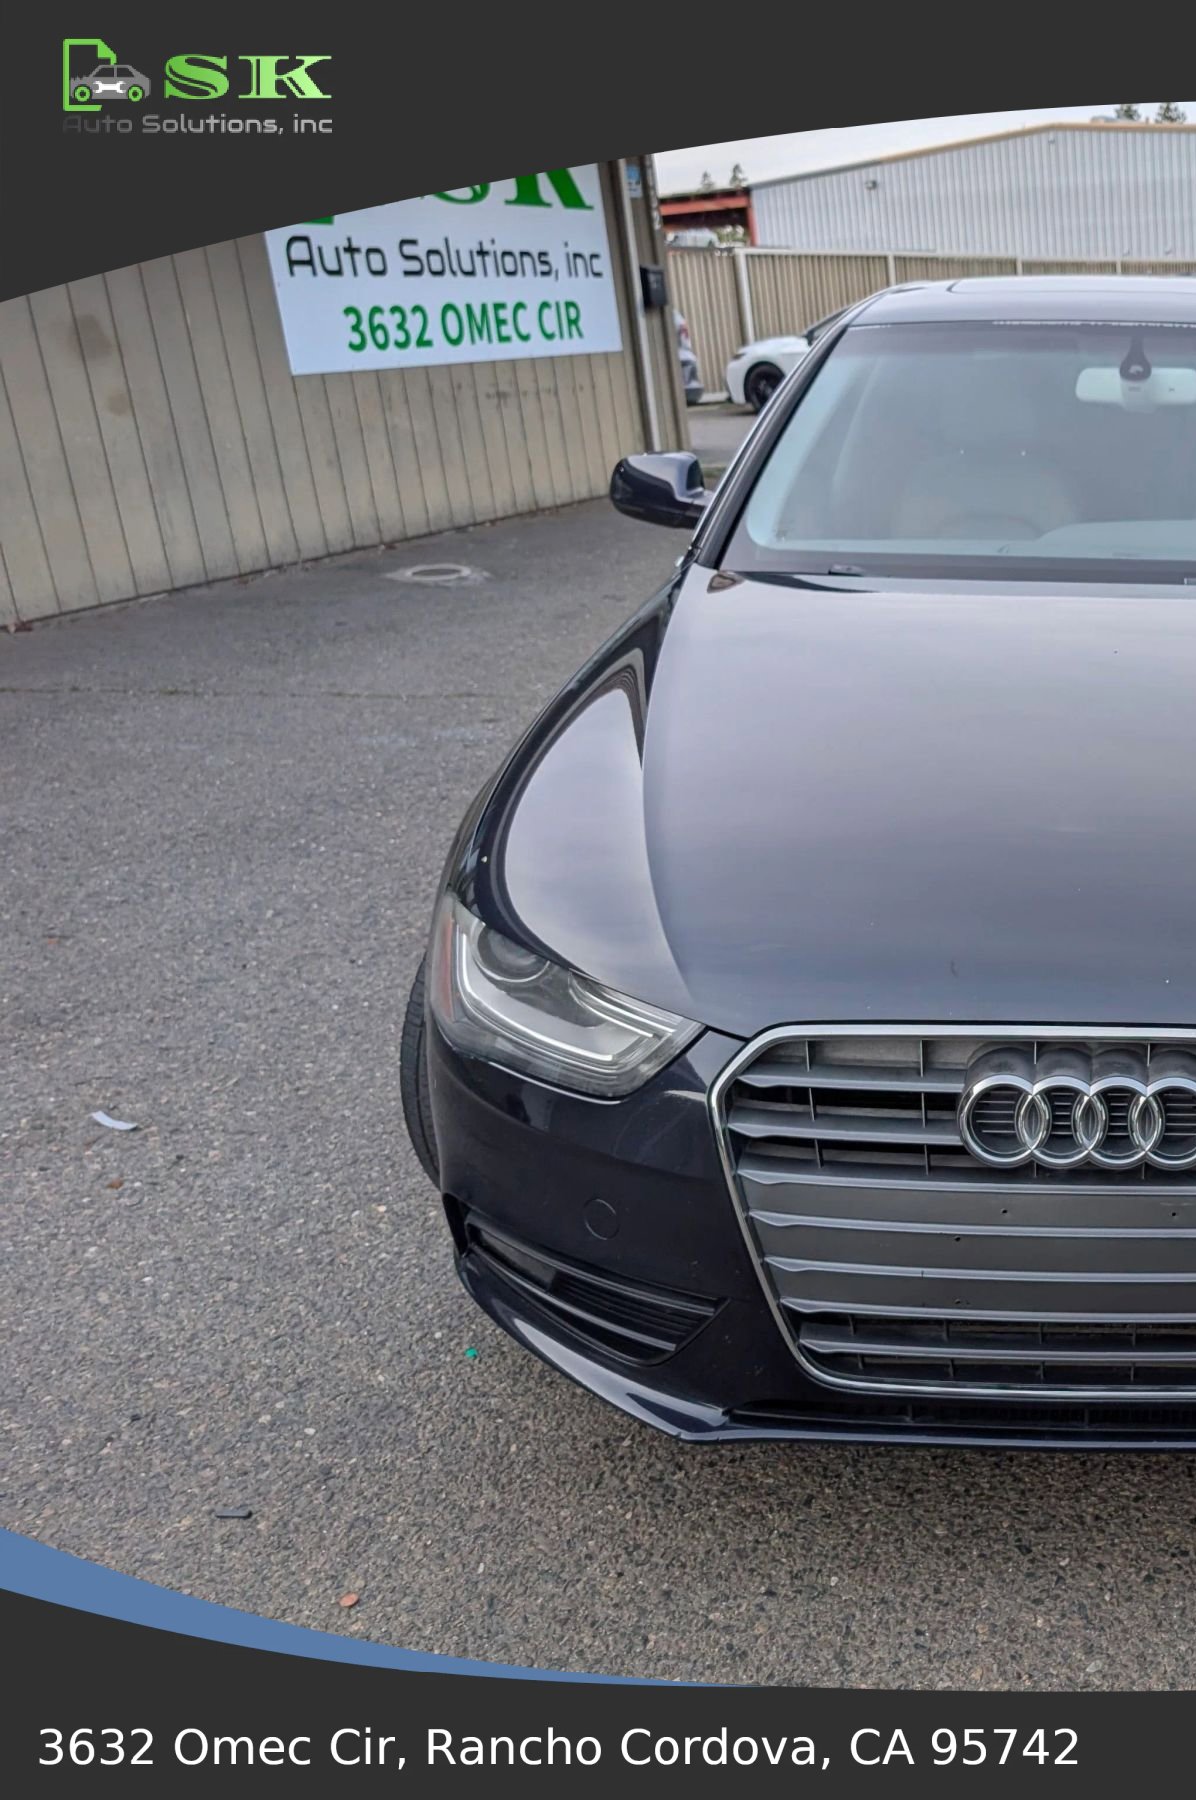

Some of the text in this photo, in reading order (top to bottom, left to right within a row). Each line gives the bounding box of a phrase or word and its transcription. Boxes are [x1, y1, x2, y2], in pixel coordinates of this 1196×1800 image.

[285, 235, 604, 281] Auto Solutions, inc
[343, 300, 584, 353] 3632 OMEC CIR
